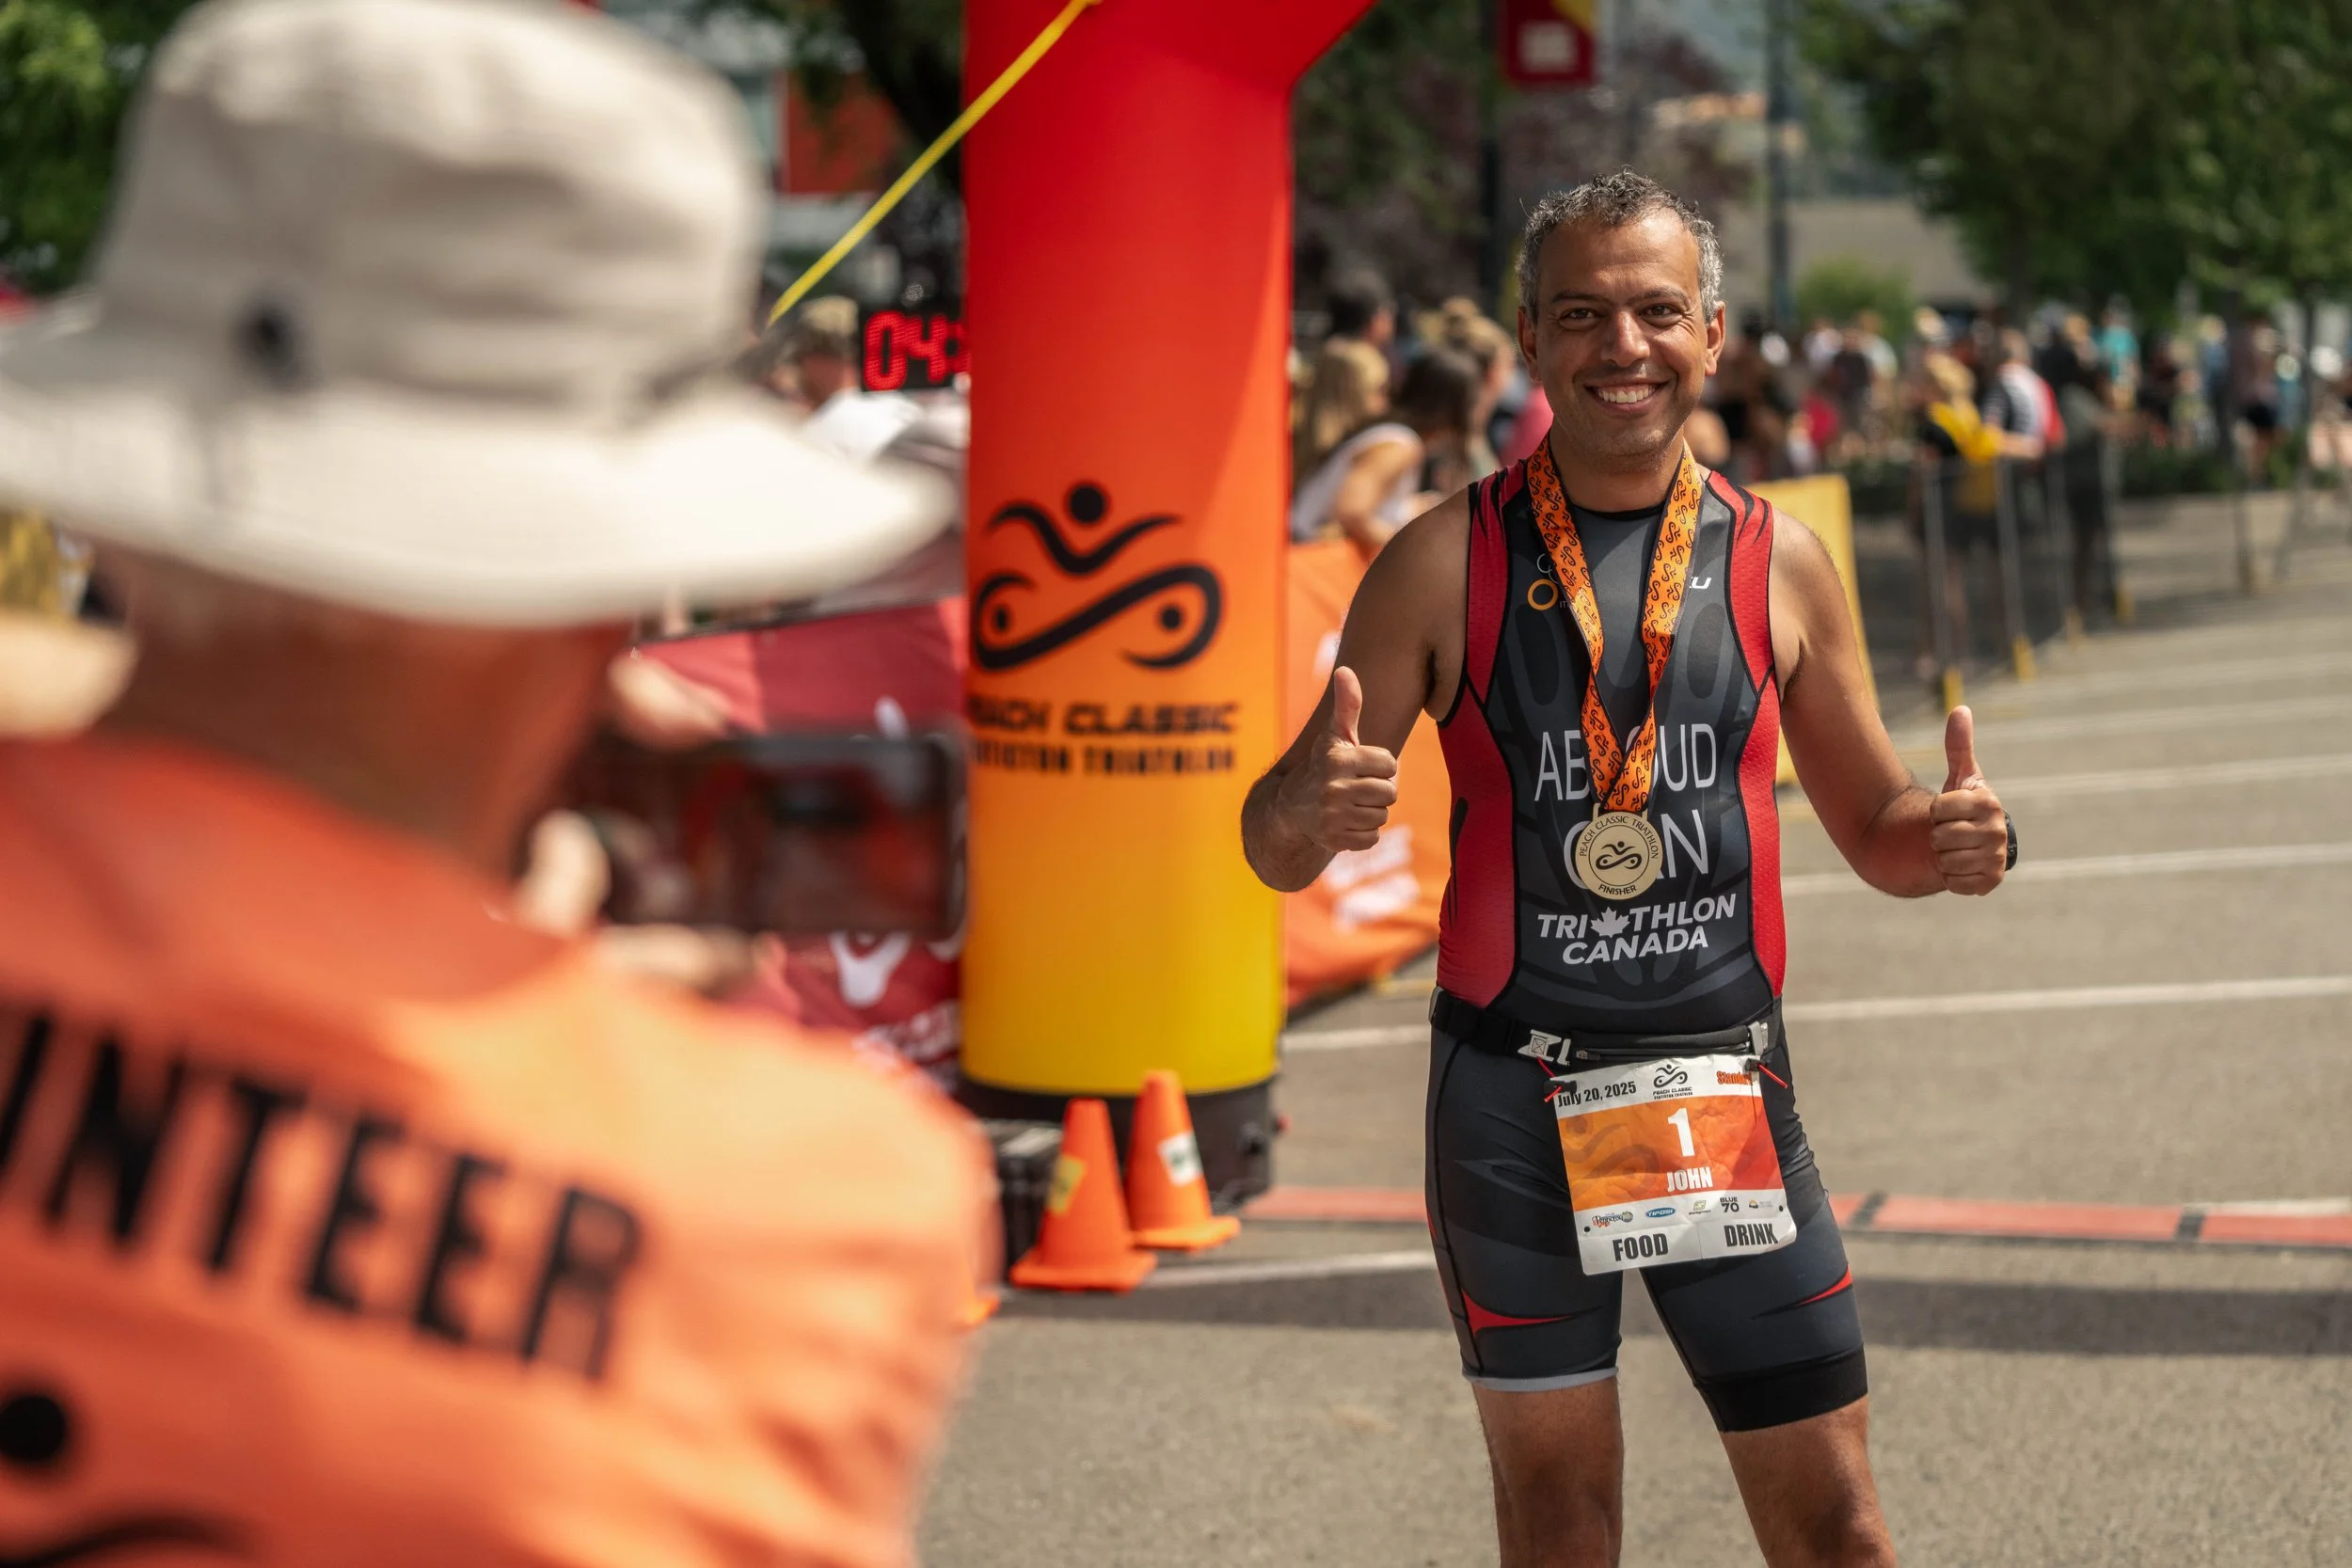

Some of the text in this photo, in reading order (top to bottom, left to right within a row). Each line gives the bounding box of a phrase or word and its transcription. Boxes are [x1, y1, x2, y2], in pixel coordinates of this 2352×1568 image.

[1064, 701, 1238, 734] CLASSIC
[1084, 743, 1233, 774] TRIATHLON
[1563, 810, 1708, 889] CN
[1580, 816, 1659, 859] PEACH CLASSIC TRIATHLON
[1598, 883, 1637, 895] FINISHER
[1537, 894, 1736, 939] TRITHLON
[1563, 925, 1708, 965] CANADA
[1557, 1081, 1637, 1107] July 20, 2025
[1667, 1107, 1695, 1158] 1
[1666, 1166, 1713, 1193] JOHN
[1721, 1203, 1740, 1213] 70
[1612, 1232, 1669, 1261] FOOD
[1724, 1223, 1778, 1248] DRINK
